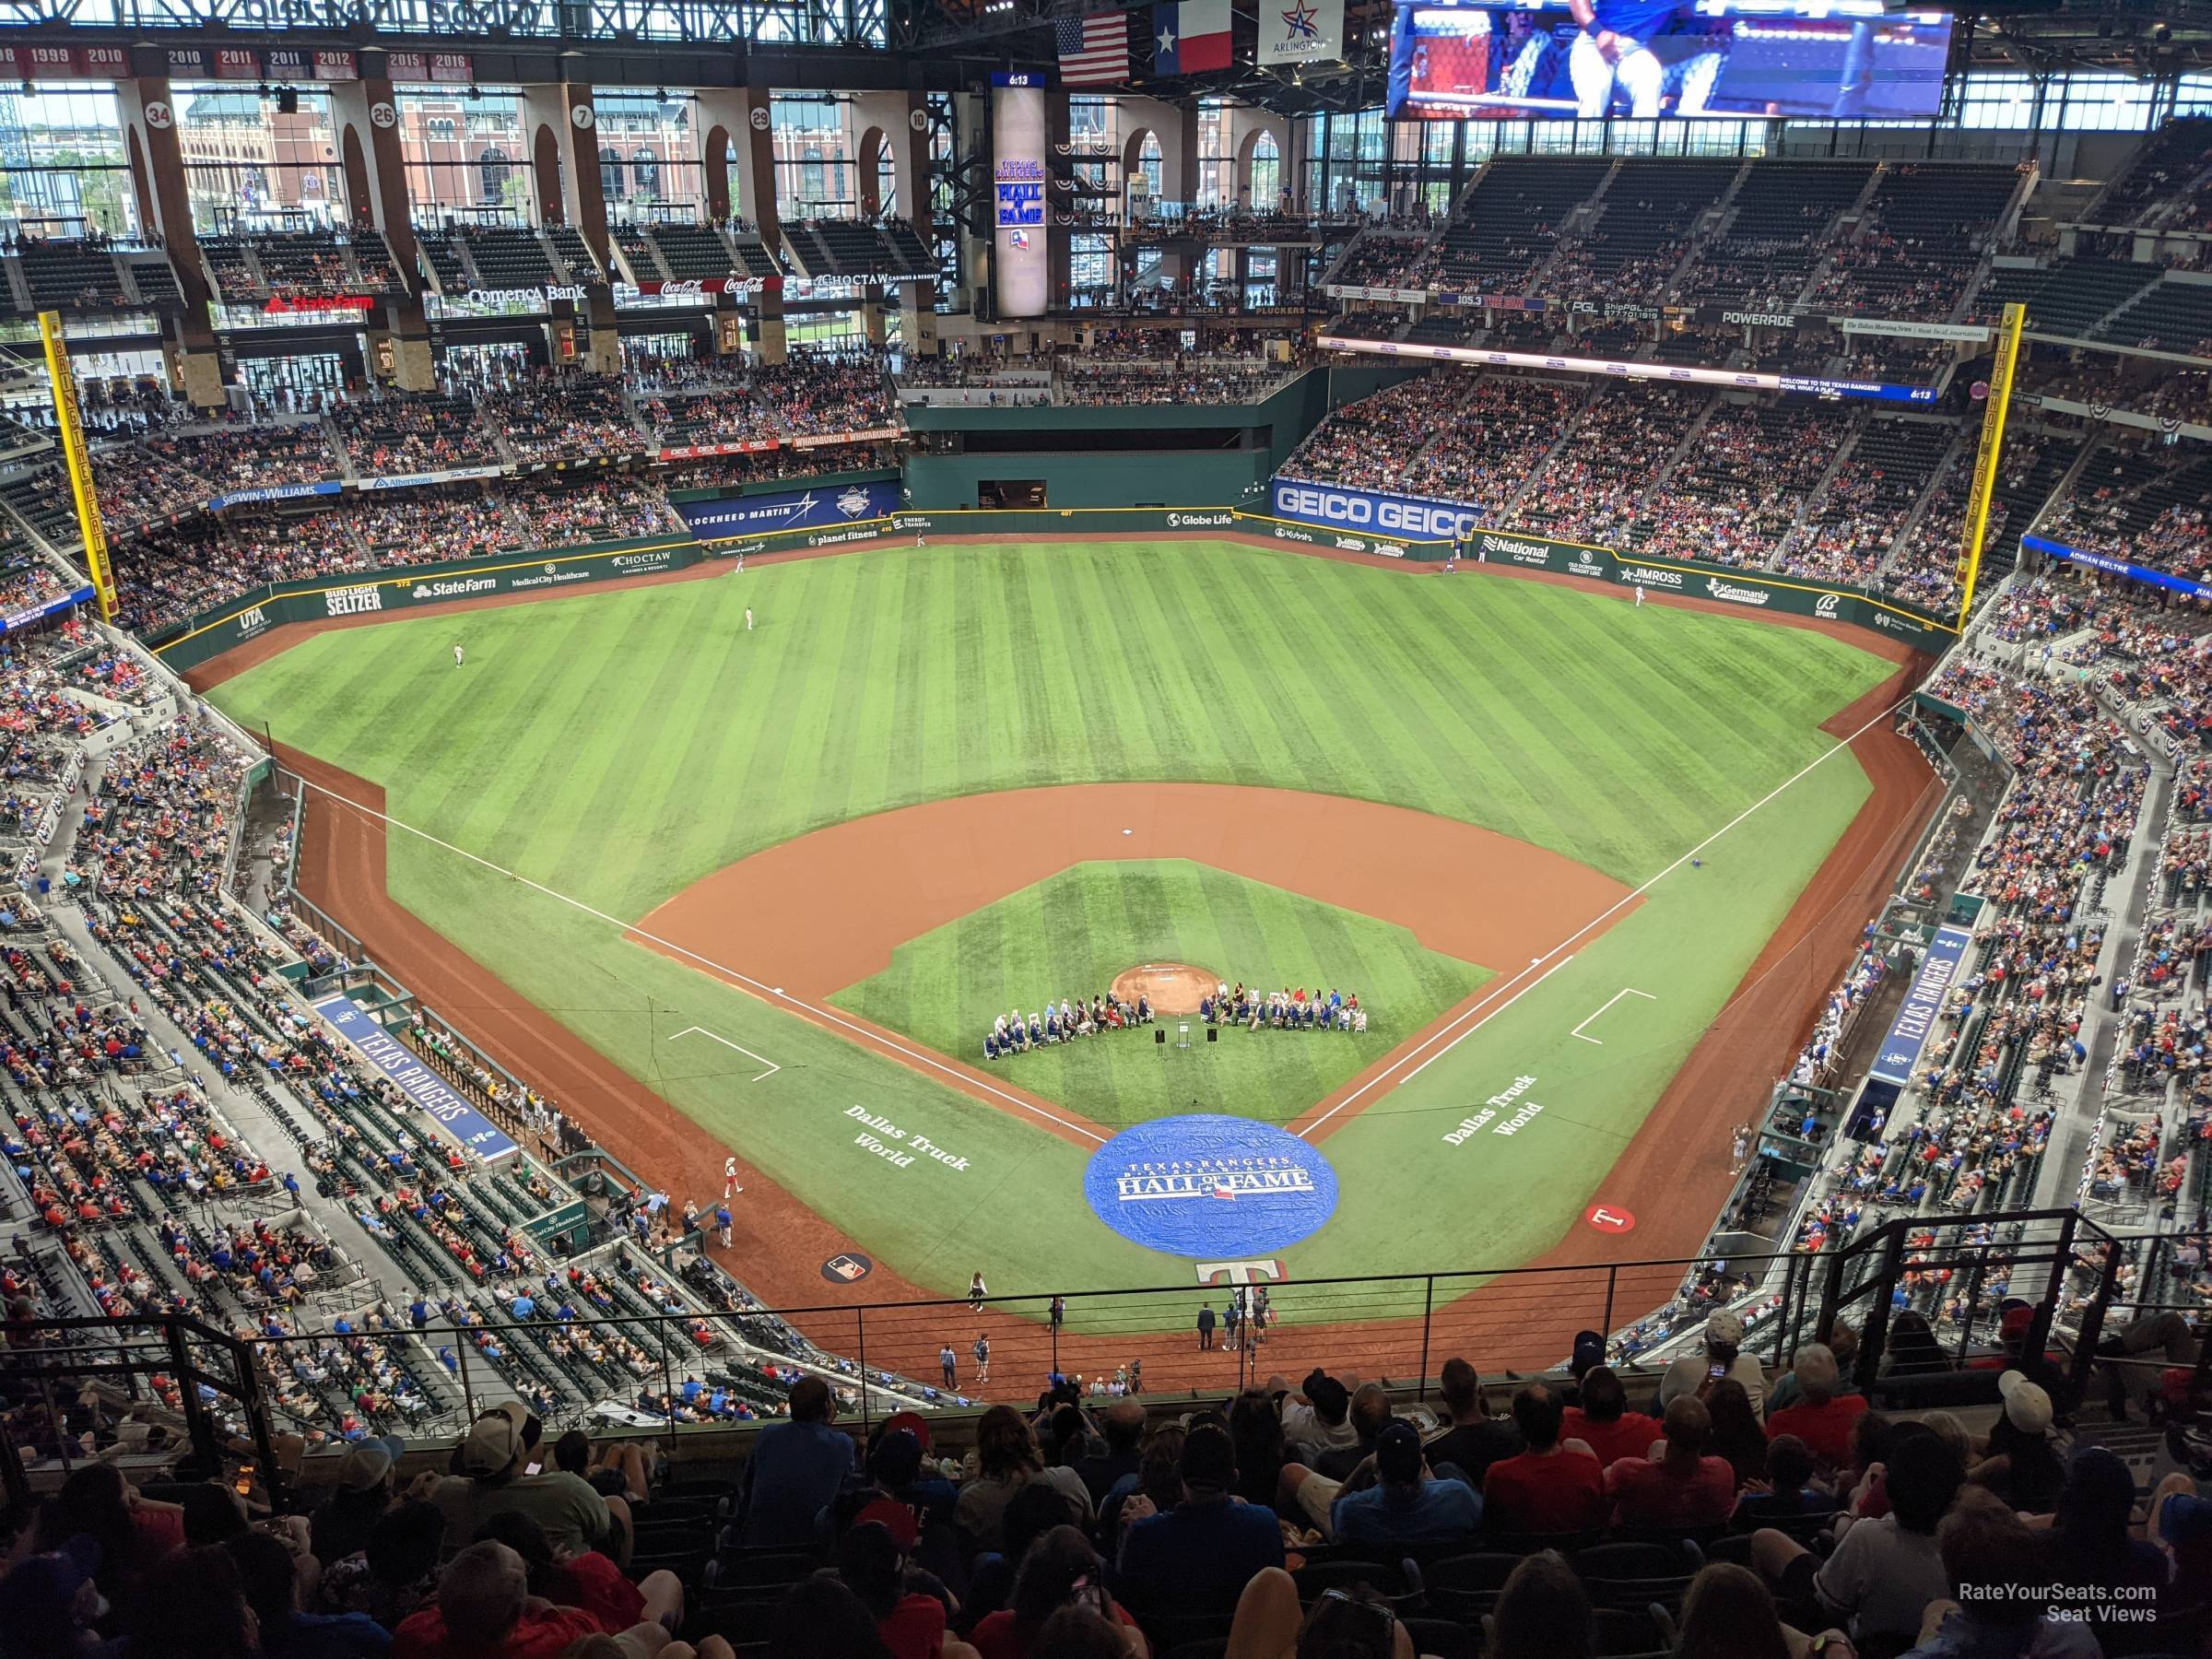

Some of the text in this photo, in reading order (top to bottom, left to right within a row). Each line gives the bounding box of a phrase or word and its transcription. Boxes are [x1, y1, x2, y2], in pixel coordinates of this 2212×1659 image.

[1274, 40, 1324, 53] ARLINGTON
[31, 49, 69, 63] 1999
[88, 49, 122, 63] 2010
[169, 51, 200, 64] 2010
[221, 51, 251, 64] 2011
[271, 51, 300, 65] 2011
[319, 52, 350, 65] 2012
[390, 53, 419, 67] 2015
[436, 54, 465, 68] 2016
[1009, 75, 1028, 85] 6:13
[148, 108, 170, 123] 34
[373, 108, 393, 123] 26
[579, 111, 588, 124] 7
[752, 112, 768, 125] 29
[912, 113, 924, 126] 10
[999, 183, 1041, 200] HALL
[999, 208, 1043, 224] FAME
[823, 273, 888, 286] CHOCTAW
[546, 284, 587, 300] Bank
[1457, 295, 1482, 305] 105.3
[1572, 301, 1598, 312] PGL
[1255, 306, 1305, 315] PLUCKERS
[1723, 312, 1794, 327] POWERADE
[1780, 377, 1809, 385] WELCOME
[1831, 381, 1850, 389] TEXAS
[1910, 390, 1931, 399] 6:13
[795, 434, 845, 448] WHATABURGER
[850, 429, 898, 442] WHATABURGER
[671, 446, 689, 455] DEX
[698, 444, 716, 454] DEX
[724, 442, 742, 453] DEX
[749, 440, 767, 449] DEX
[389, 475, 433, 488] Albertsons
[1277, 487, 1371, 524] GEICO
[688, 507, 791, 526] LOCKHEED MARTIN
[1182, 514, 1232, 525] Globe Life
[1378, 501, 1479, 538] GEICO
[818, 529, 877, 547] planet fitness
[618, 551, 671, 567] CHOCTAW
[1524, 556, 1546, 565] Rental
[512, 571, 590, 587] Medical City Healthcare
[325, 584, 379, 598] BUD LIGHT
[1724, 583, 1769, 600] Germania
[326, 592, 382, 617] SELTZER
[240, 607, 265, 629] UTA
[1815, 609, 1837, 619] SPORTS
[1894, 957, 1954, 1041] TEXAS RANGERS
[357, 1031, 469, 1122] TEXAS RANGERS
[1441, 1075, 1537, 1146] Dallas Truck
[1492, 1101, 1545, 1136] World
[843, 1104, 971, 1172] Dallas Truck
[853, 1132, 915, 1169] World
[1129, 1156, 1289, 1171] TEXAS RANGERS
[1117, 1171, 1313, 1195] HALL OF FAME
[1592, 1209, 1625, 1226] T
